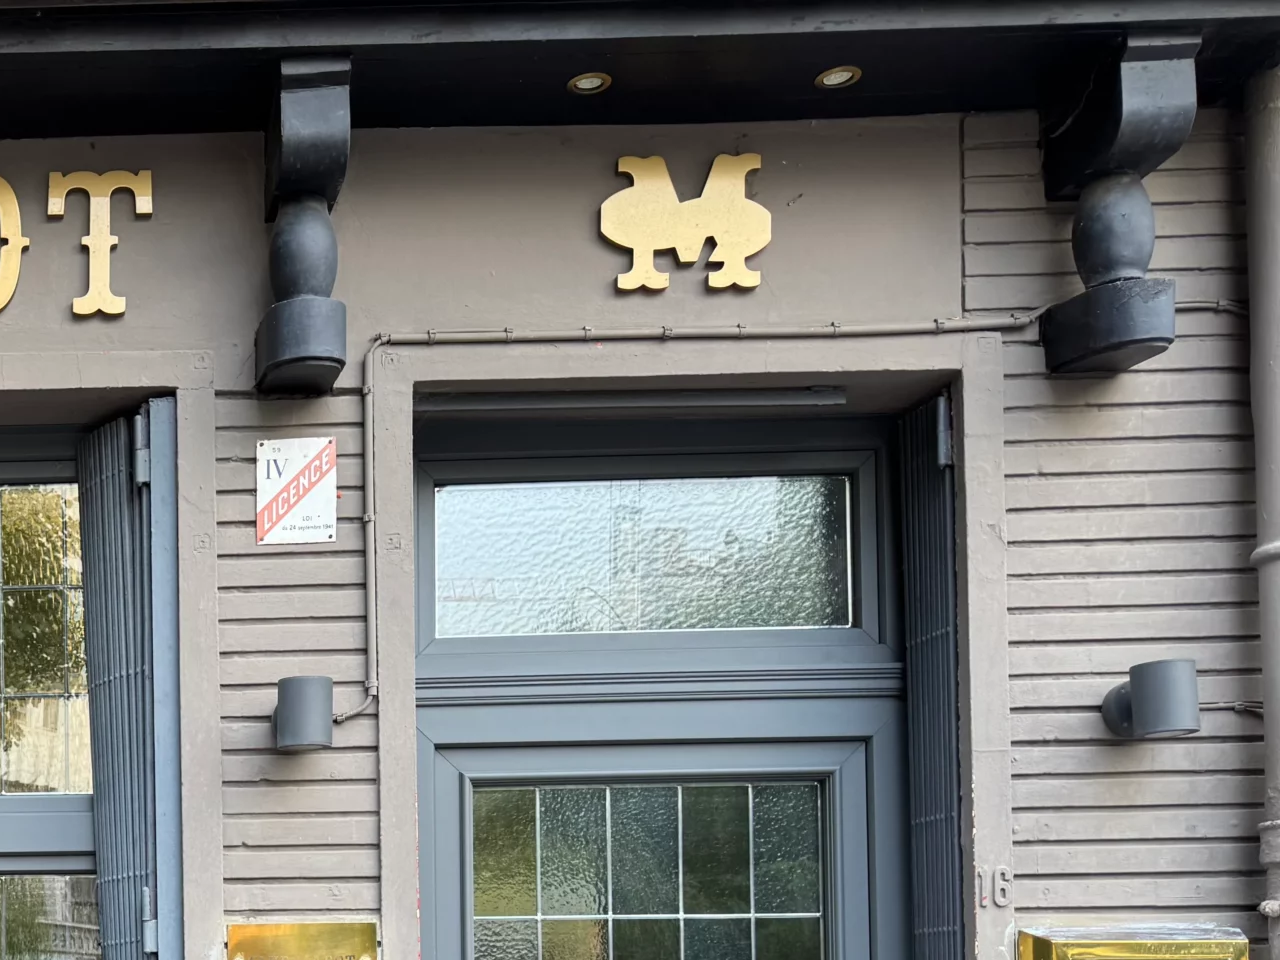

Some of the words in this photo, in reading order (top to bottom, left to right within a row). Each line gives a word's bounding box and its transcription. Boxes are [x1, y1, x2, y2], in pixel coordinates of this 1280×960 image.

[263, 448, 331, 531] LICENCE
[265, 458, 289, 480] IV
[977, 865, 1012, 909] 16
